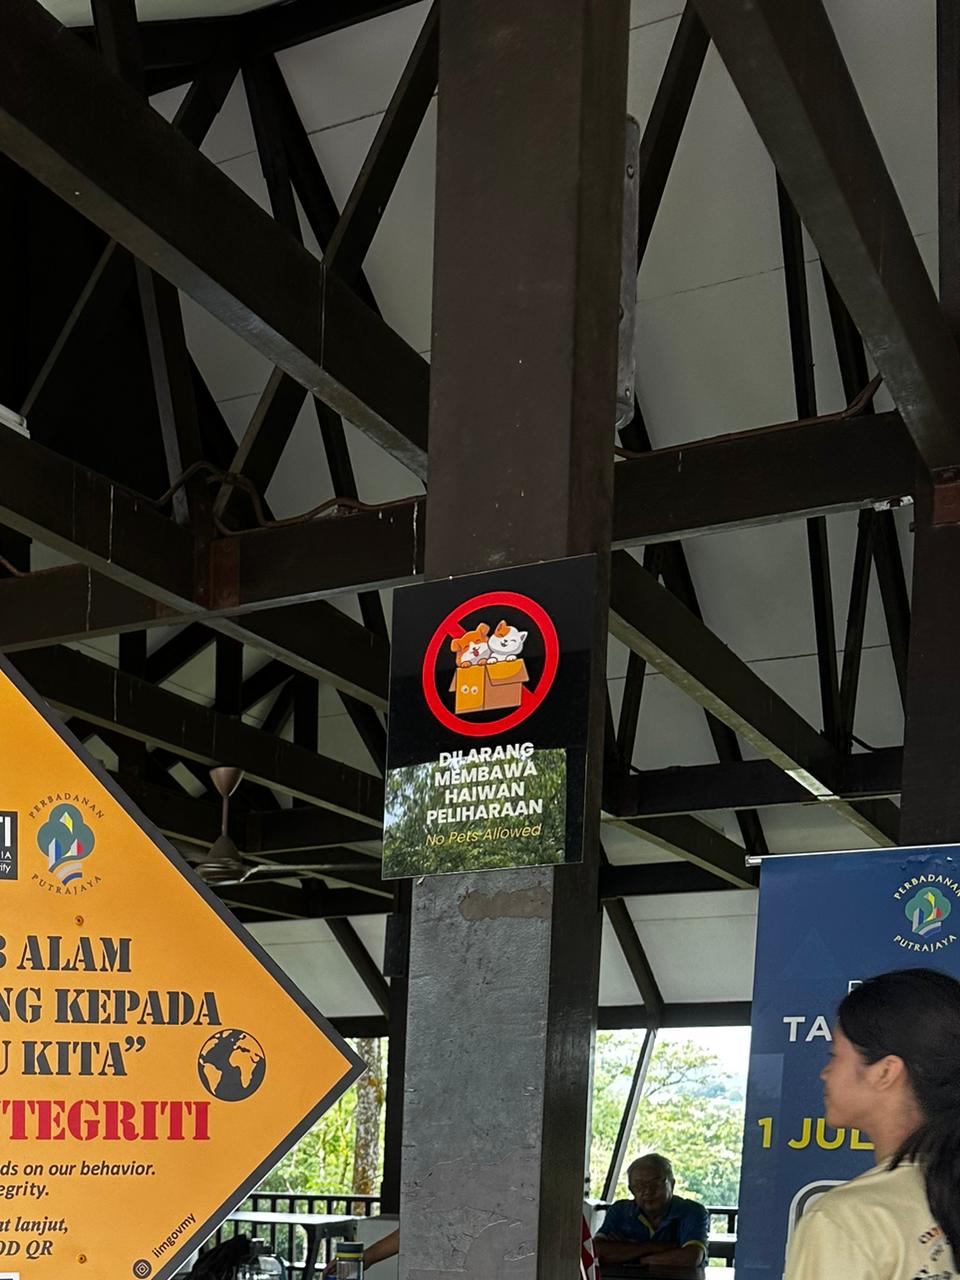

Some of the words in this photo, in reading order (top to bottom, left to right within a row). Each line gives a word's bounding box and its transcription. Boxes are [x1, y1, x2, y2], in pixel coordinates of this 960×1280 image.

[439, 742, 534, 767] DILARANG
[434, 762, 538, 787] MEMBAWA
[445, 781, 525, 804] HAIWAN
[29, 792, 104, 819] PERBADANAN
[426, 799, 543, 824] PELIHARAAN
[426, 834, 445, 846] No
[448, 831, 479, 844] Pets
[483, 823, 542, 840] Allowed
[31, 873, 101, 895] PUTRAJAYA
[16, 936, 133, 973] ALAM
[893, 934, 957, 953] PUTRAJAYA
[53, 988, 223, 1026] KEPADA
[21, 1036, 147, 1077] KITA”
[758, 1117, 774, 1148] 1
[23, 1163, 43, 1176] on
[48, 1163, 76, 1176] our
[80, 1160, 156, 1176] behavior.
[14, 1216, 69, 1236] lanjut,
[151, 1213, 197, 1259] iimgovmy
[25, 1240, 54, 1260] QR
